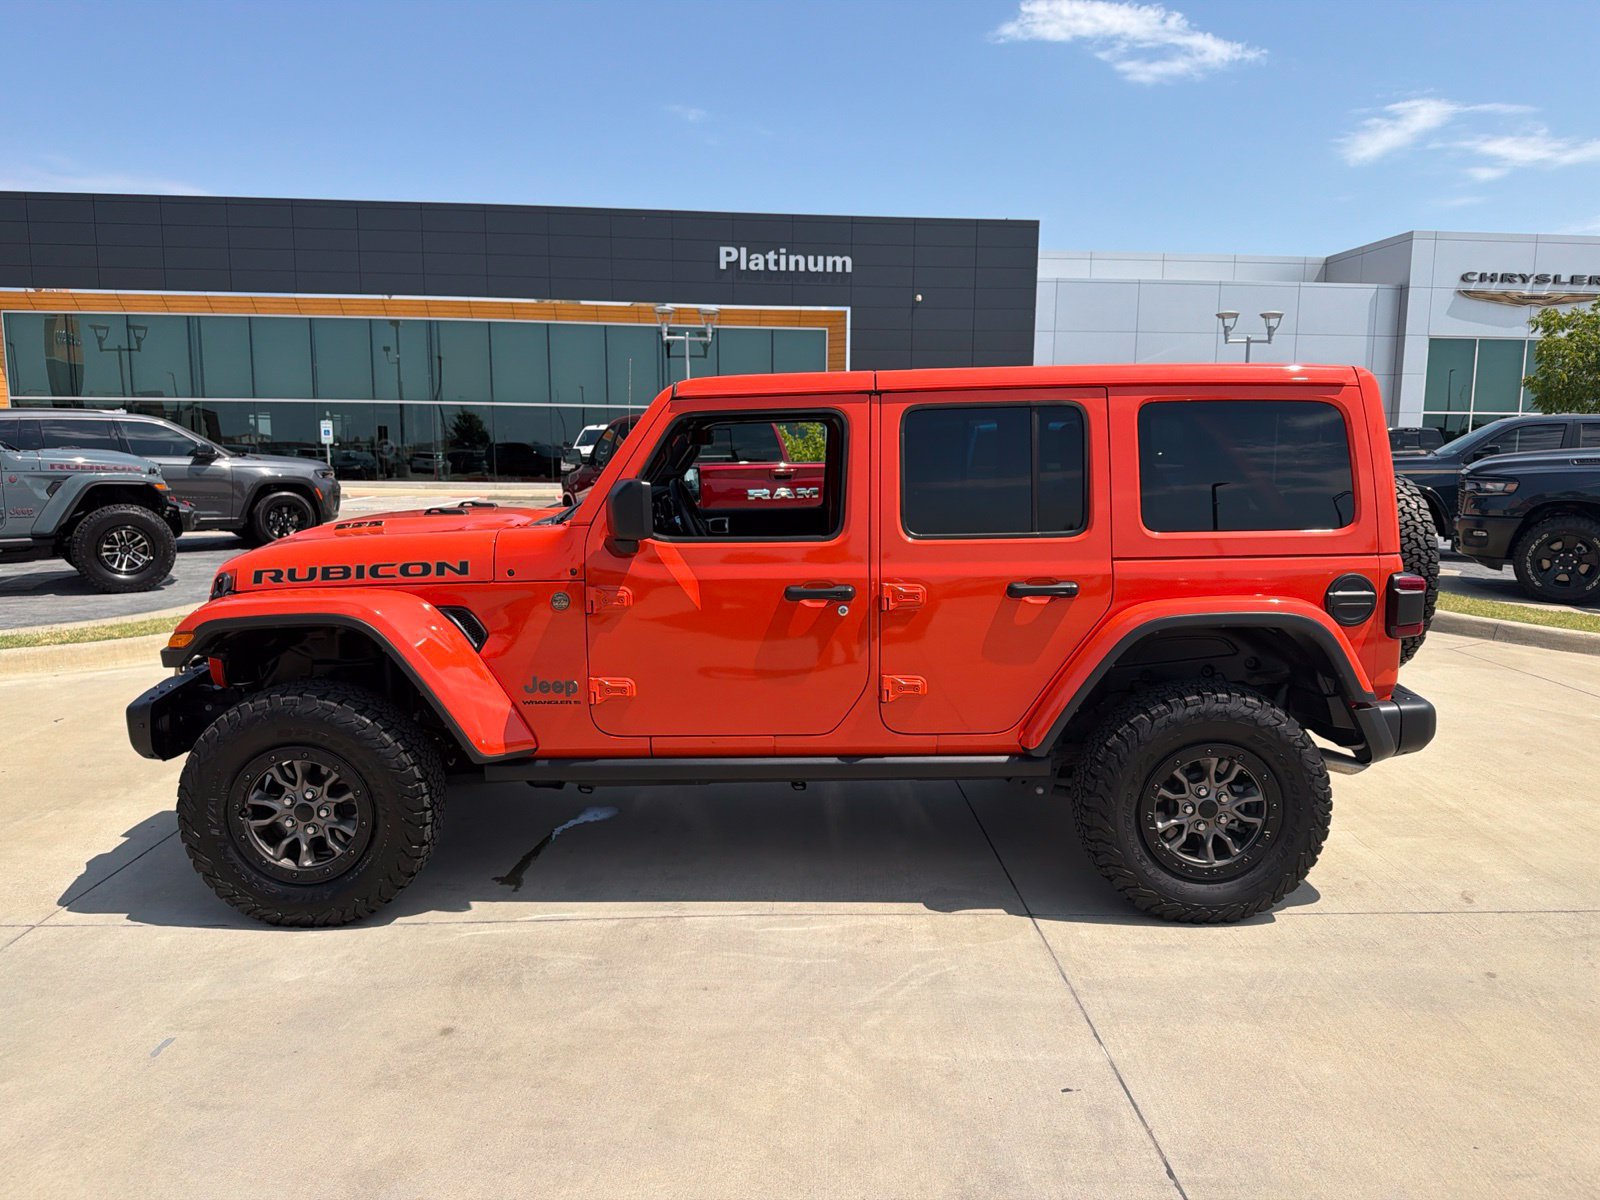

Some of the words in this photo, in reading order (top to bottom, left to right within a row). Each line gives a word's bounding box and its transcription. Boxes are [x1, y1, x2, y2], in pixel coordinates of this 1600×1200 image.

[719, 246, 853, 273] Platinum
[49, 463, 142, 471] RUBICON
[747, 487, 819, 500] RAM
[252, 560, 469, 584] RUBICON
[524, 676, 578, 697] Jeep
